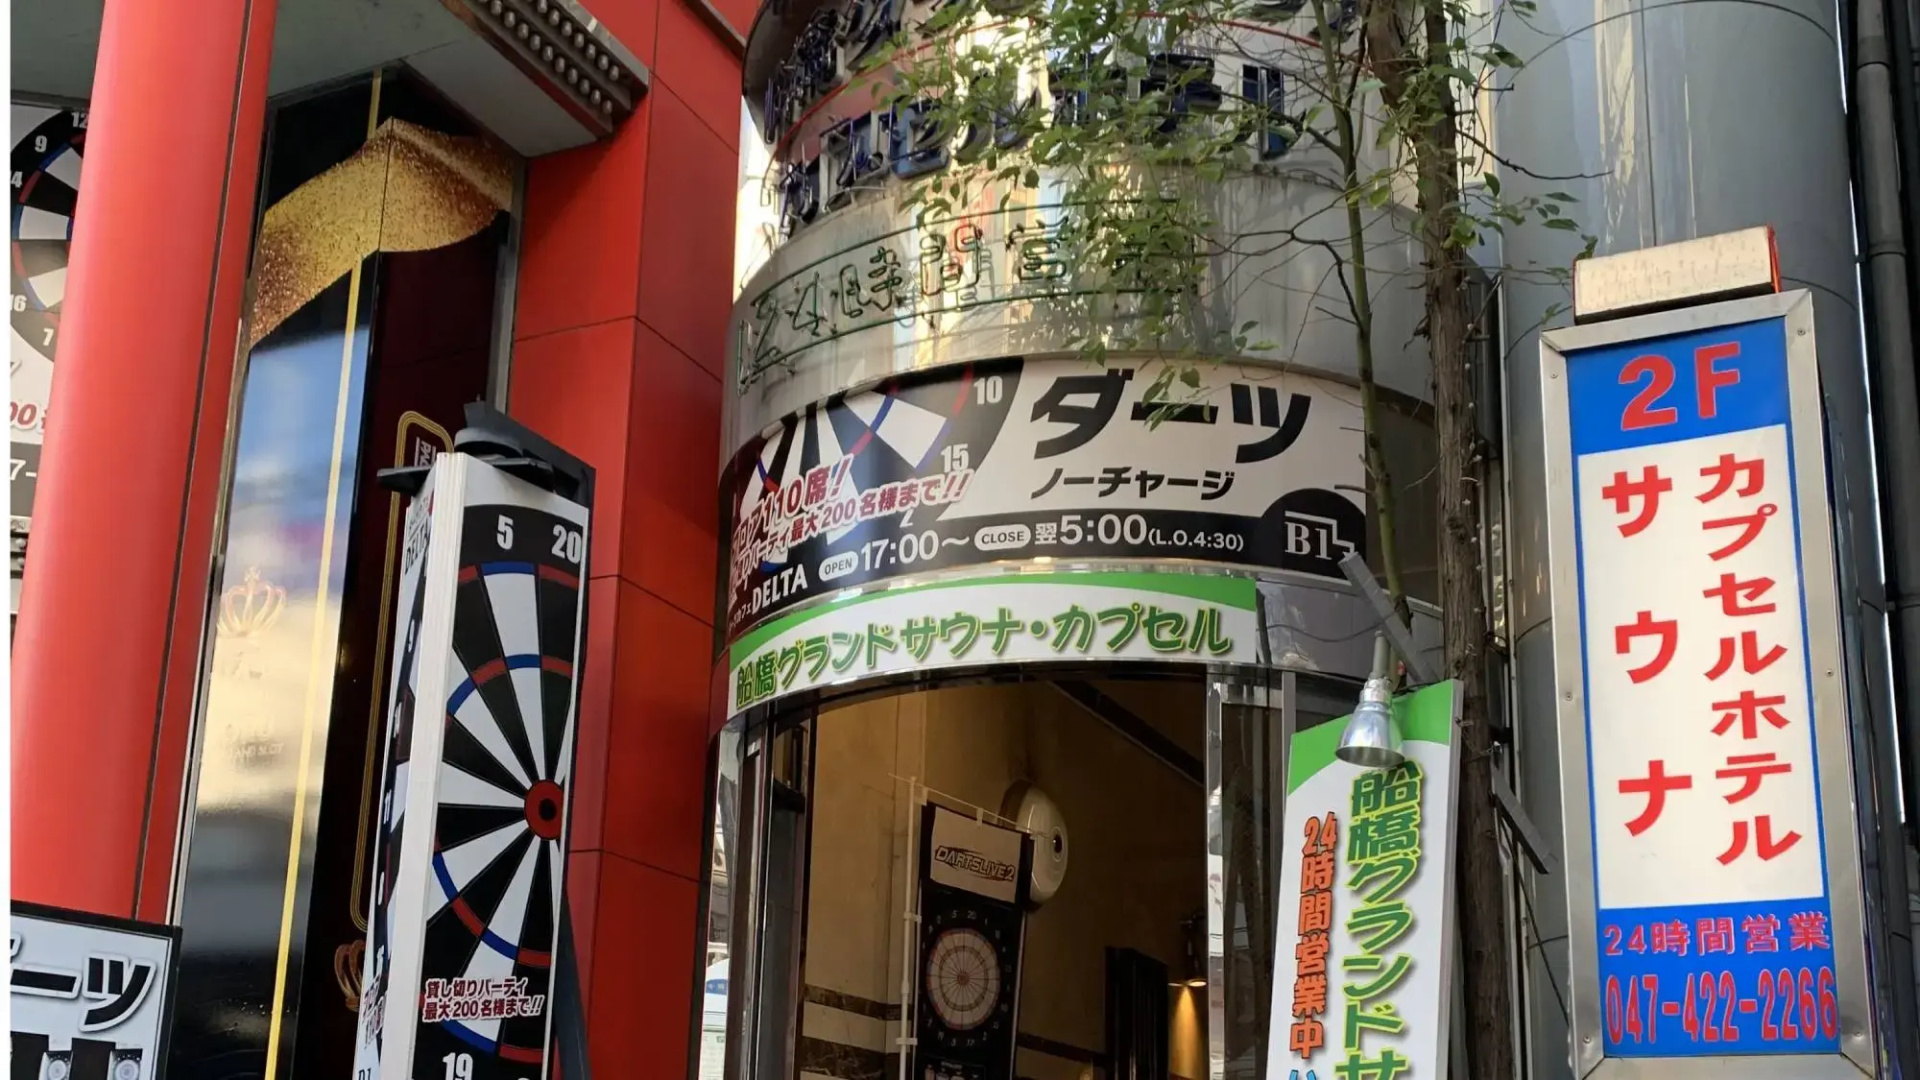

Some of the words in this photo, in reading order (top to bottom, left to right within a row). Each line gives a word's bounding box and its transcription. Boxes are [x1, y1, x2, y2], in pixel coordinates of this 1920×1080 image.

[34, 135, 47, 153] 9
[10, 171, 23, 188] 4
[43, 328, 54, 346] 7
[973, 375, 1004, 405] 10
[1618, 341, 1741, 431] 2F
[1030, 367, 1312, 464] ダーツ
[941, 443, 970, 472] 15
[1030, 466, 1236, 500] ノーチャージ
[496, 514, 514, 550] 5
[551, 524, 582, 564] 20
[1285, 522, 1333, 561] B1
[824, 558, 853, 575] OPEN
[981, 530, 1025, 544] CLOSE
[752, 564, 808, 615] DELTA
[1601, 464, 1694, 838] サウナ
[1694, 452, 1804, 867] カプセルホテル
[934, 845, 1016, 882] DARTSLIVE2
[1289, 810, 1338, 1060] 24時間営業中
[1603, 911, 1831, 957] 24時間営業
[10, 937, 153, 1028] ーツ
[1605, 965, 1838, 1045] 047-422-2266
[442, 1052, 473, 1080] 19
